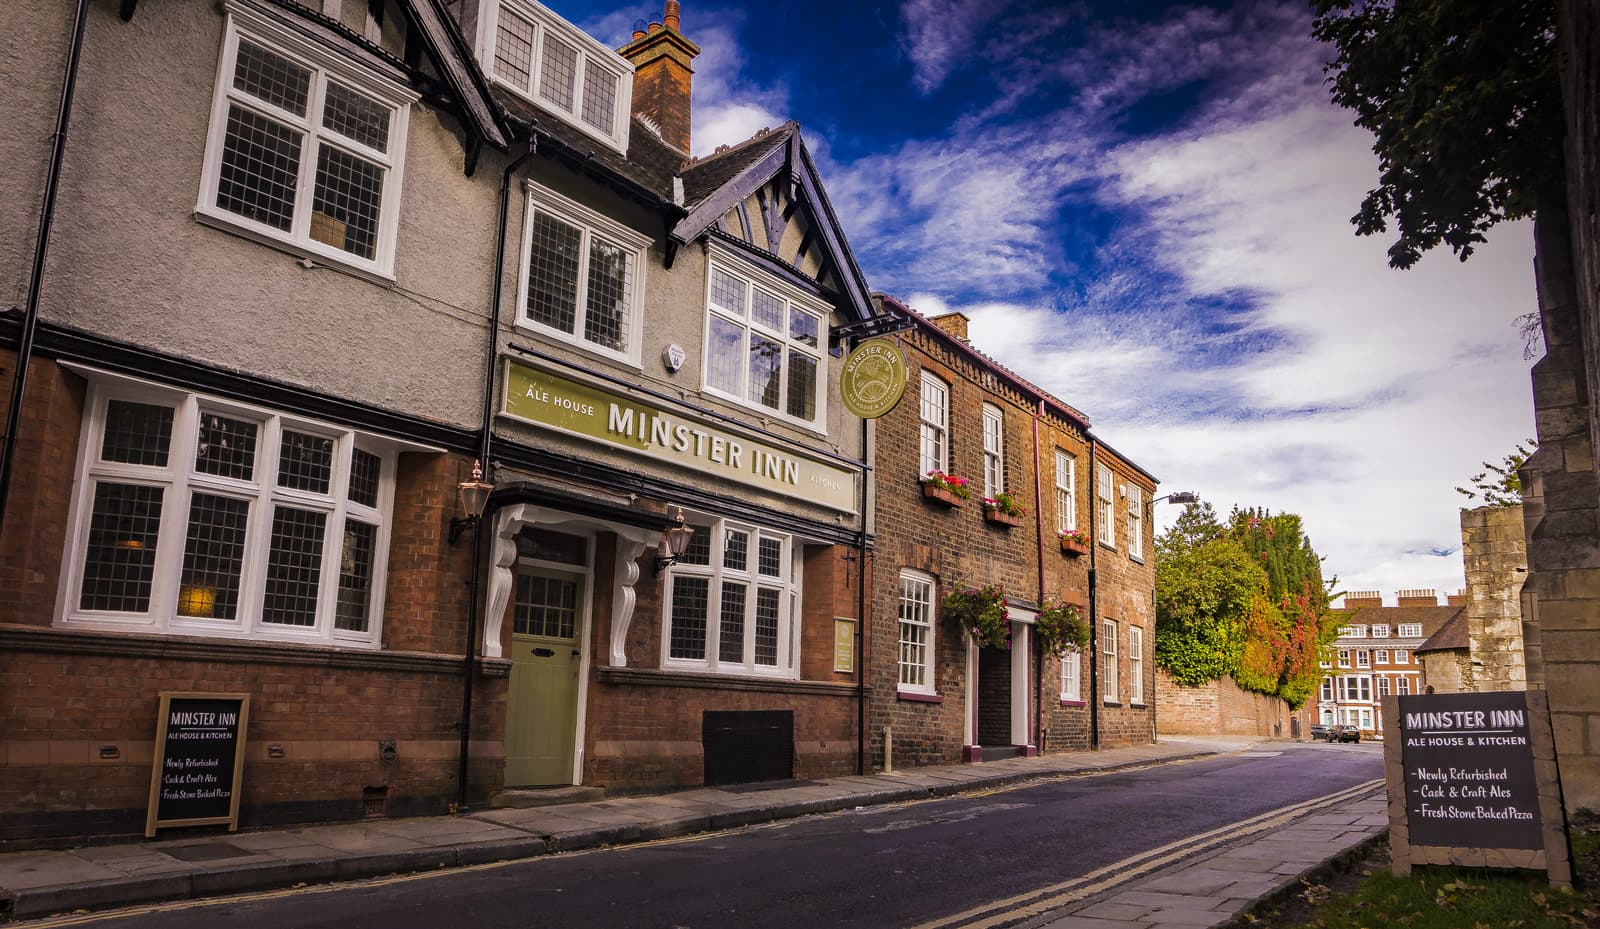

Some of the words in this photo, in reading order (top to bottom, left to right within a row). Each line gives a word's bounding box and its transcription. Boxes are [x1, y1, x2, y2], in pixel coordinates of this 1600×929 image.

[848, 346, 881, 373] MINSTER
[883, 348, 897, 364] INN
[526, 388, 549, 403] ALE
[554, 398, 594, 417] HOUSE
[608, 403, 742, 469] MINSTER
[753, 450, 799, 485] INN
[810, 474, 841, 492] KITCHEN
[170, 712, 215, 726] MINSTER
[218, 712, 236, 726] INN
[1406, 711, 1486, 729] MINSTER
[1489, 709, 1525, 728] INN
[168, 732, 178, 740] ALE
[179, 732, 200, 740] HOUSE
[206, 732, 232, 740] KITCHEN
[1407, 738, 1426, 747] ALE
[1429, 737, 1464, 746] HOUSE
[1467, 737, 1475, 746] &
[1478, 736, 1526, 746] KITCHEN
[166, 758, 184, 769] Newly
[185, 758, 219, 767] Refurbished
[186, 773, 204, 784] Craft
[1449, 767, 1508, 780] Refurbished
[1449, 786, 1459, 798] &
[1461, 785, 1487, 798] Craft
[1489, 785, 1511, 798] Ales
[1448, 805, 1476, 819] Stone
[1475, 805, 1508, 819] Baked
[1508, 806, 1533, 820] Pizza
